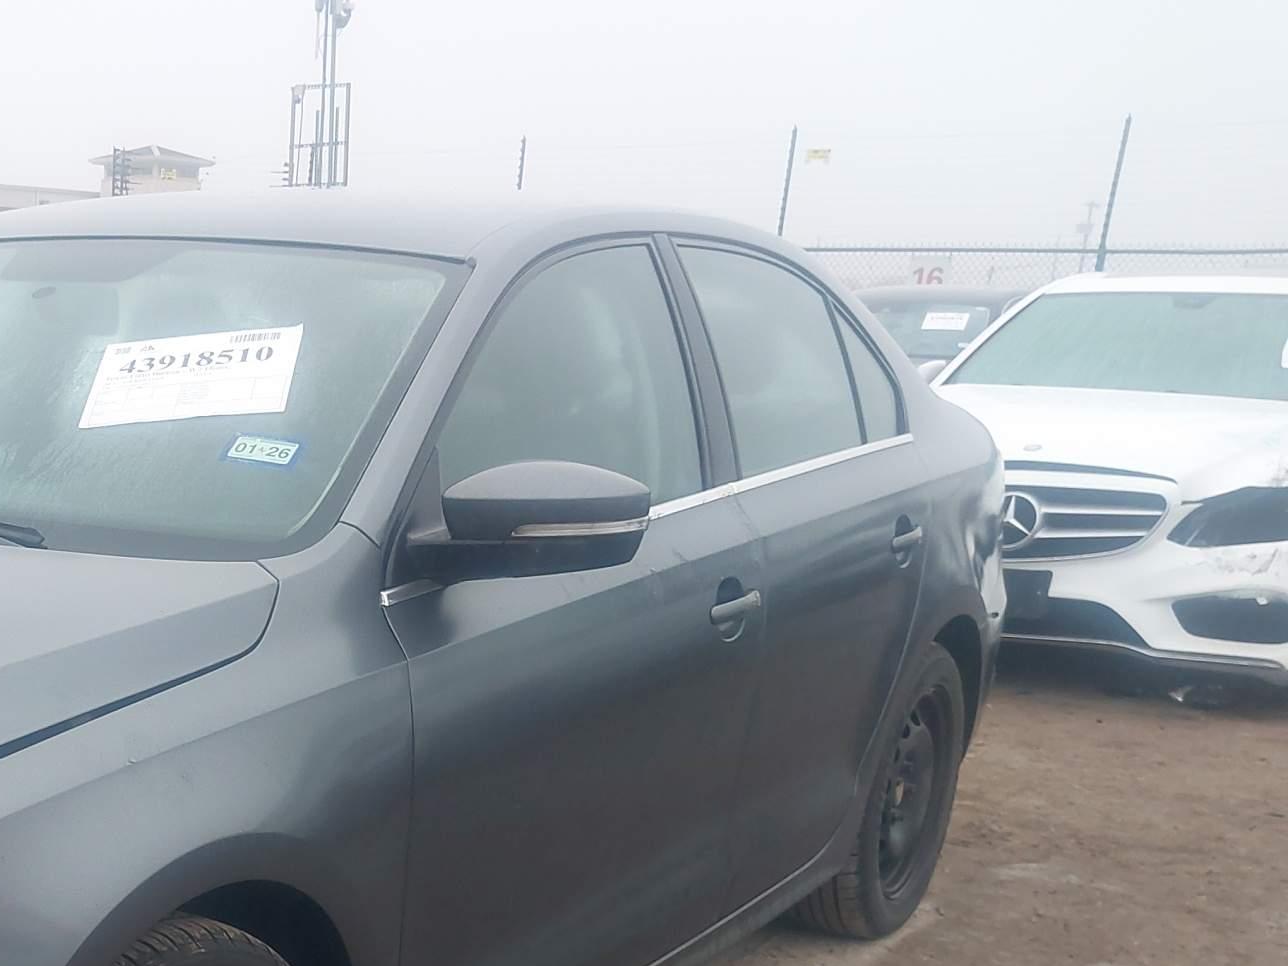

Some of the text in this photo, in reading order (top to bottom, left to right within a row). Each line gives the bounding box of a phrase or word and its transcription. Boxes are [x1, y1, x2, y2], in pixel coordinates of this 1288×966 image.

[913, 266, 944, 285] 16
[119, 346, 274, 374] 43918510
[234, 442, 291, 459] 01 26
